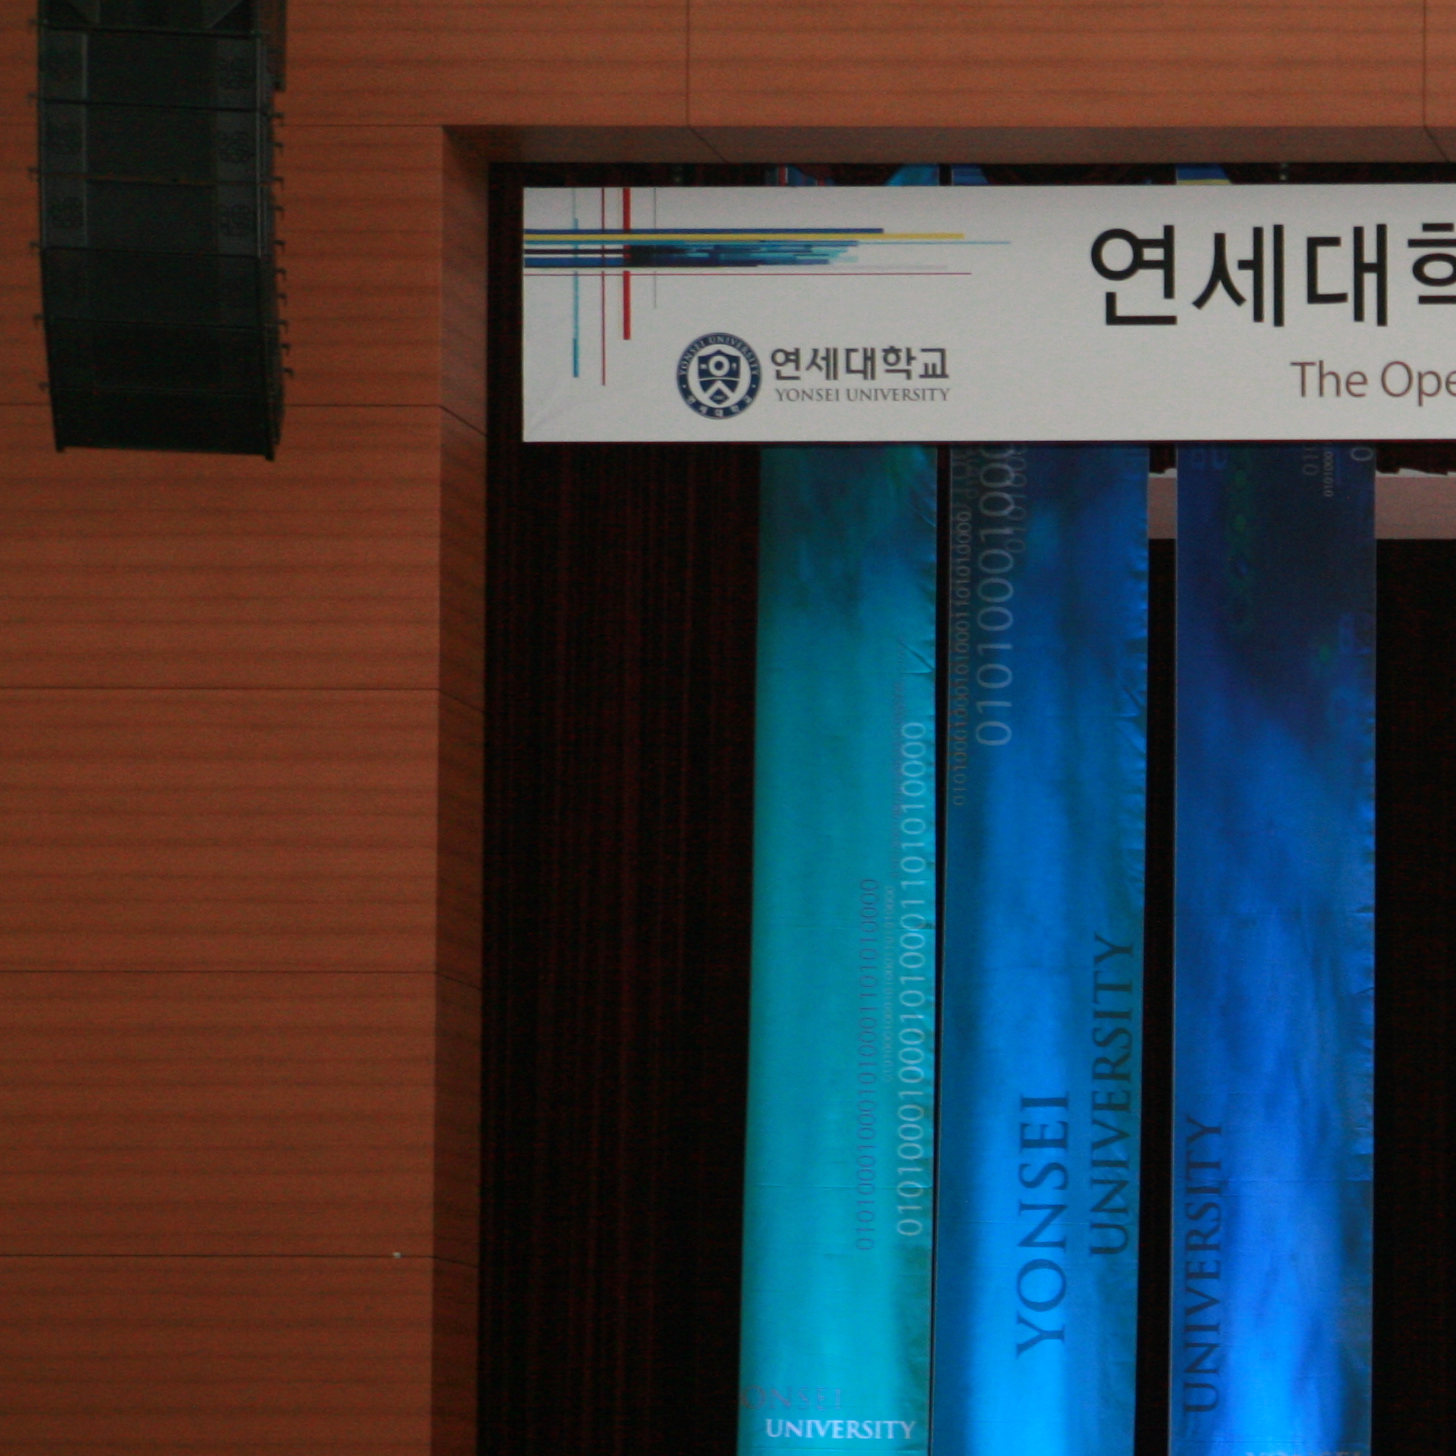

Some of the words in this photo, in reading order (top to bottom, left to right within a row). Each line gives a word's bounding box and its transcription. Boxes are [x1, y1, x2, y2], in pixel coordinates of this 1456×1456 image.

[770, 345, 950, 381] 연세대학교
[1289, 359, 1369, 399] The
[775, 388, 840, 402] YONSEI
[846, 388, 950, 402] UNIVERSITY
[1088, 931, 1134, 1256] UNIVERSITY
[1016, 1092, 1069, 1359] YONSEI
[1183, 1114, 1225, 1416] UNIVERSITY
[765, 1418, 916, 1440] UNIVERSITY
